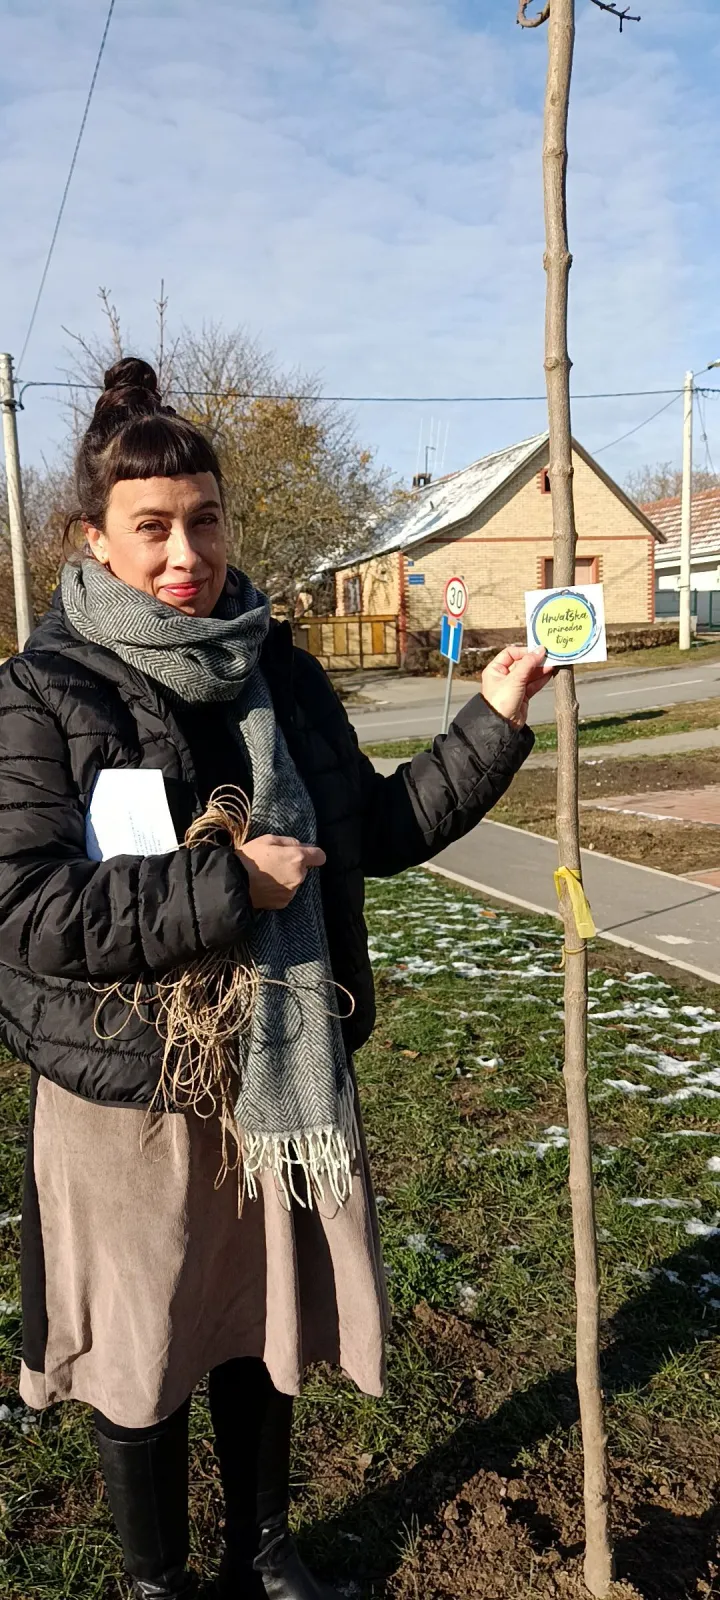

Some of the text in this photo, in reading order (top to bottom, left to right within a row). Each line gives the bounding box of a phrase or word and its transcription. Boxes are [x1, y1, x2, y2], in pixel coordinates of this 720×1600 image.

[450, 587, 463, 609] 30
[541, 608, 588, 623] Hrvatska
[547, 622, 583, 636] prirodno
[556, 634, 574, 648] tvoja
